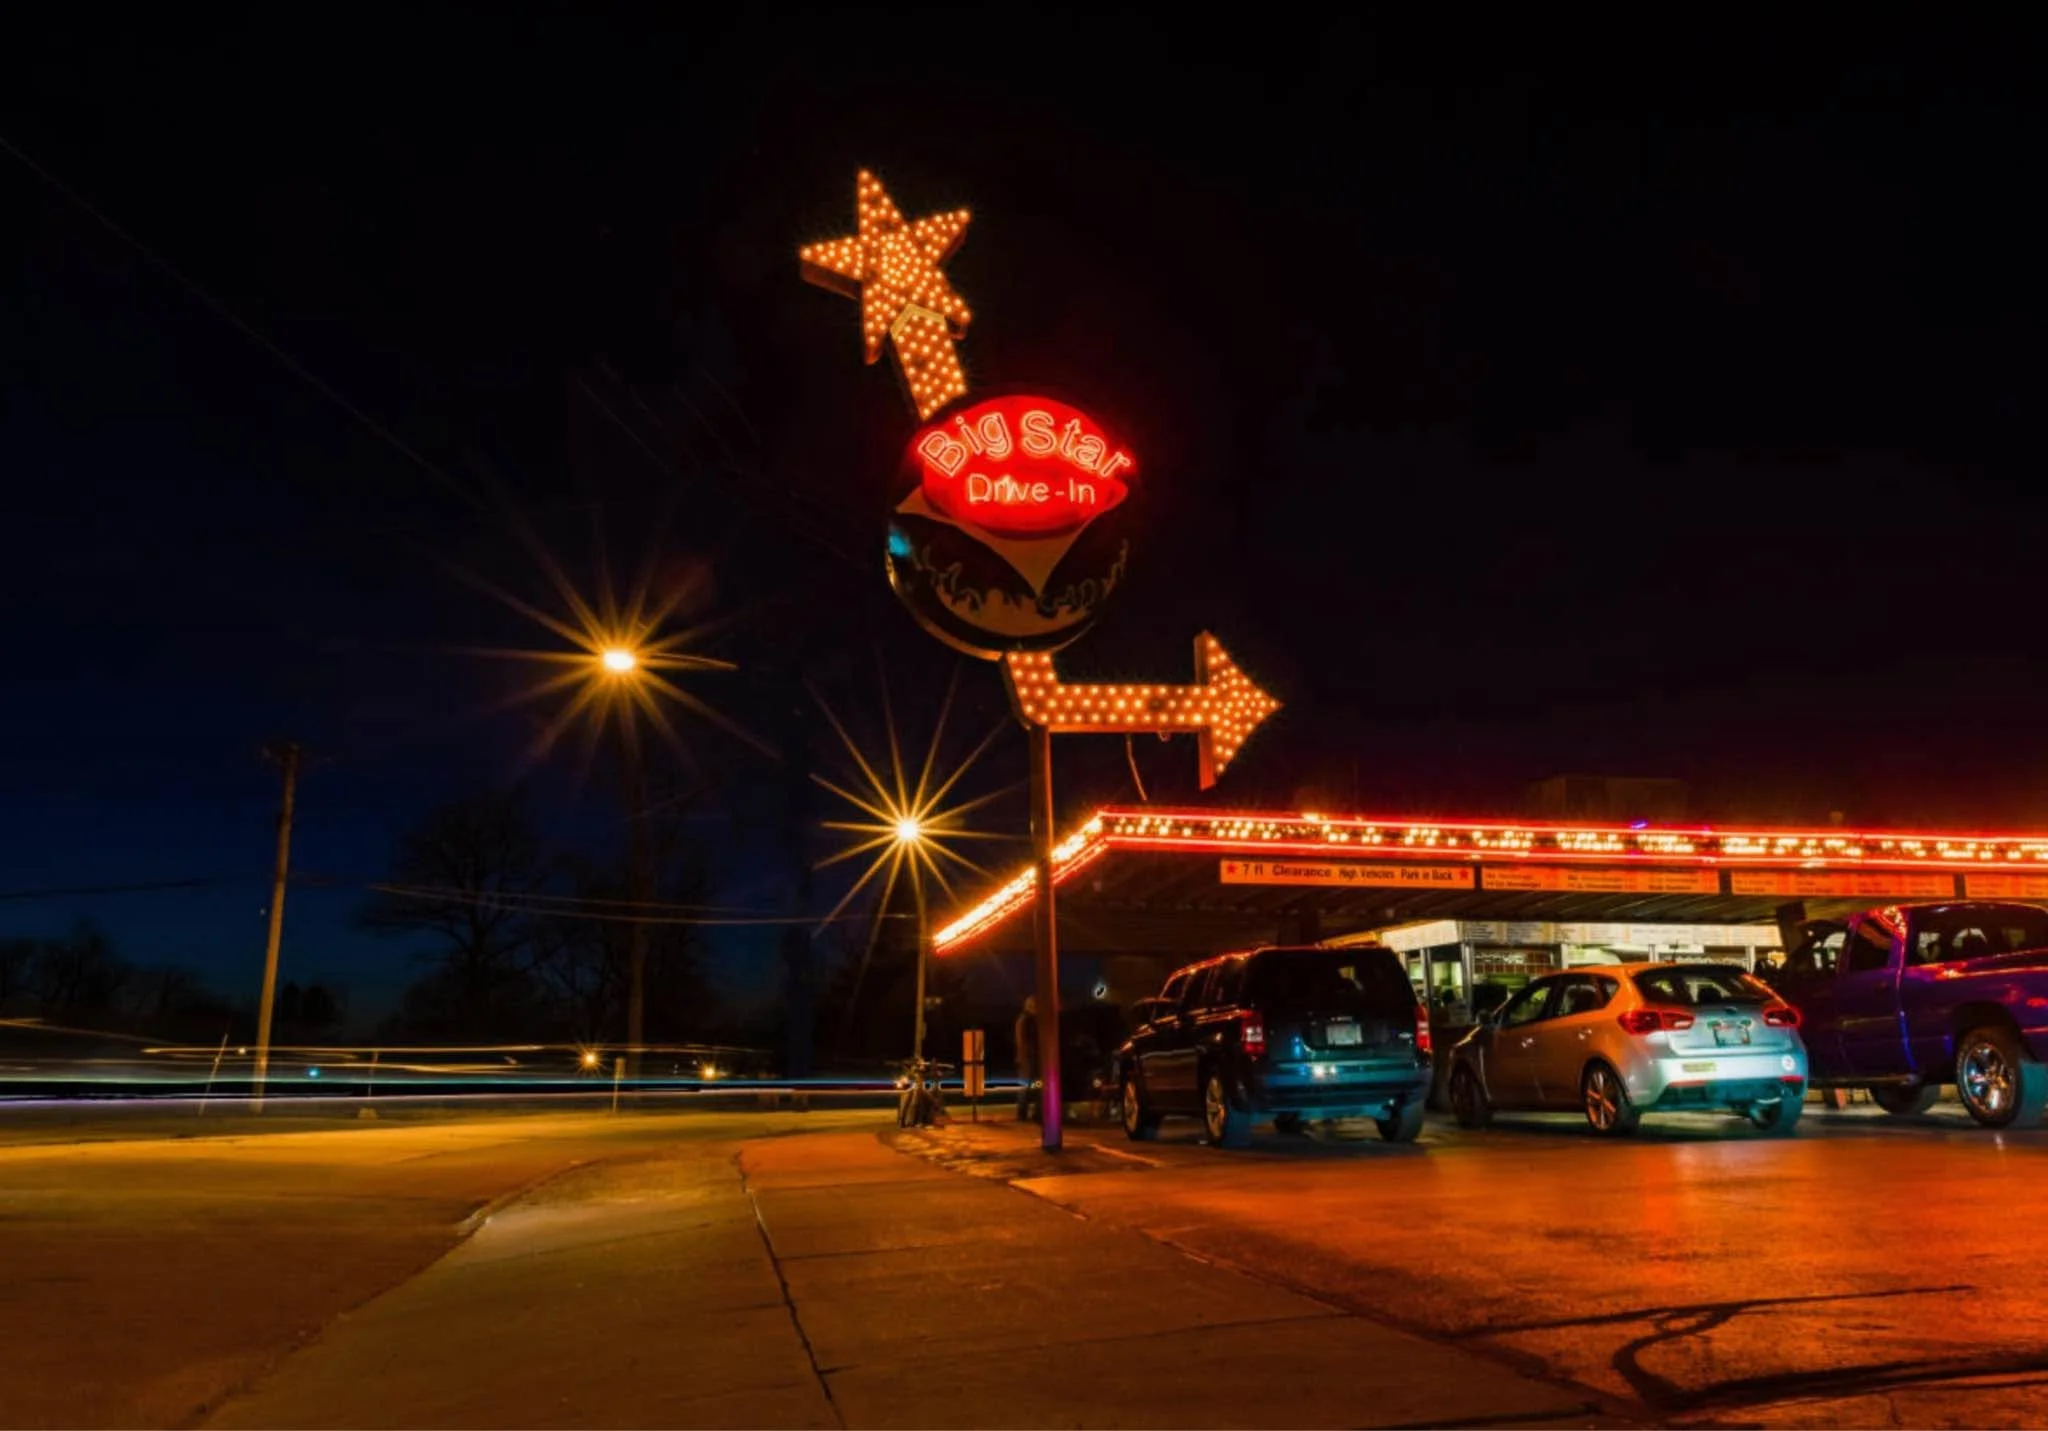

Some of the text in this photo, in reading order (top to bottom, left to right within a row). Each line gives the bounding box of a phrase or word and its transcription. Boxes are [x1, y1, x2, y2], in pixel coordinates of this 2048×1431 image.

[918, 410, 1131, 478] Big Star
[967, 473, 1096, 504] Drive-In
[1242, 863, 1250, 875] 7
[1272, 863, 1332, 878] Clearance
[1400, 868, 1419, 880] Park
[1432, 868, 1453, 881] Back
